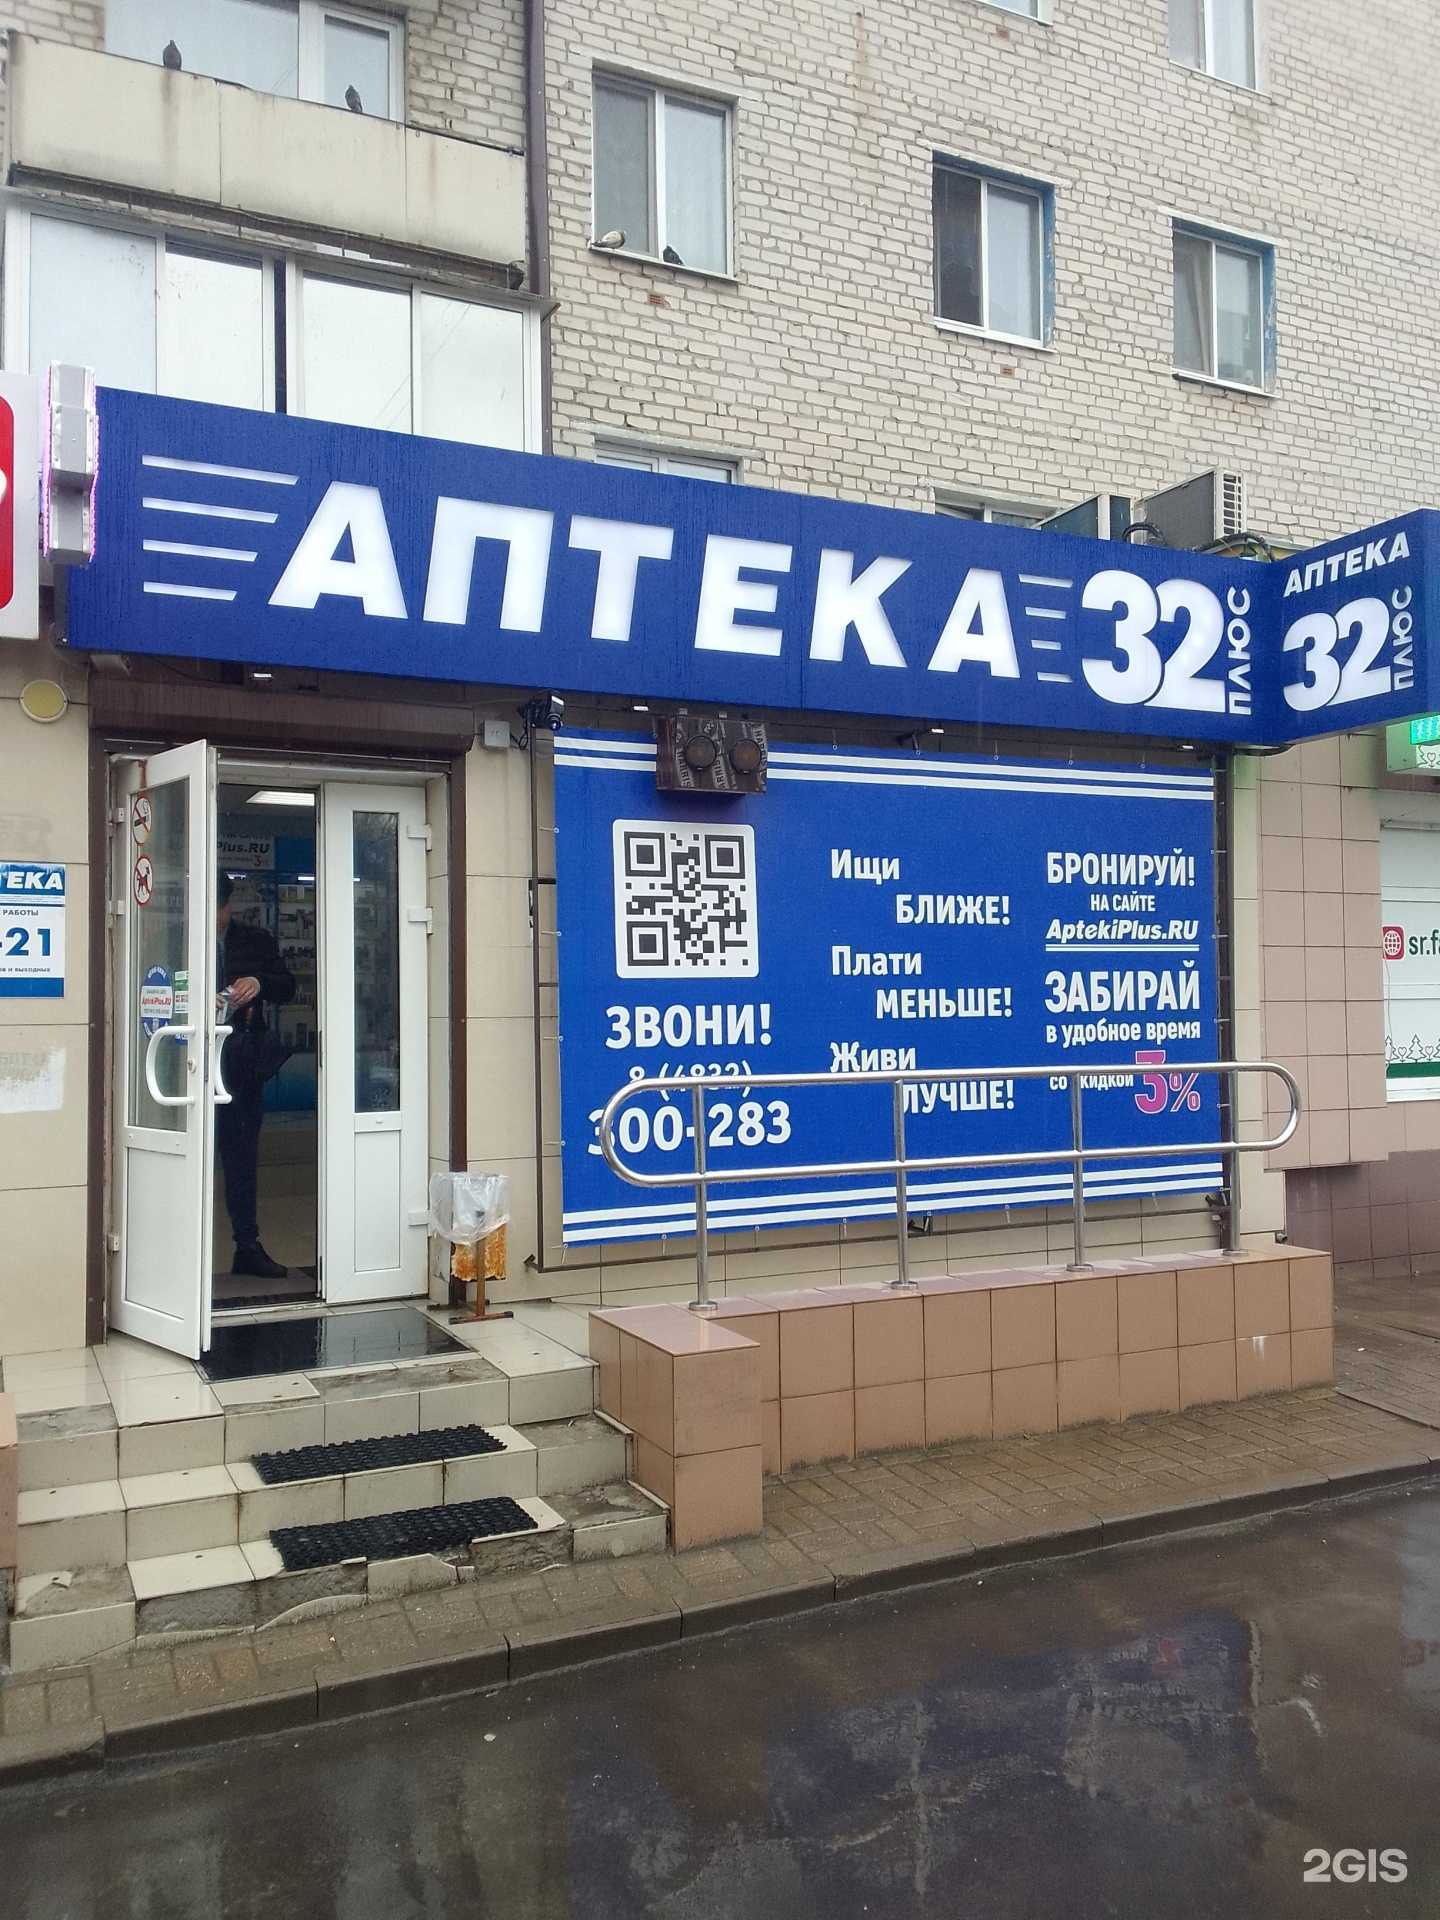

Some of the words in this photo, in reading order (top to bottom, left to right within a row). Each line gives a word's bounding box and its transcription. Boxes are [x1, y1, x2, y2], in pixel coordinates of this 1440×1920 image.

[1283, 532, 1411, 597] АПТЕКА
[268, 480, 1020, 679] АПТЕКА
[1082, 569, 1226, 714] 32
[1227, 586, 1252, 715] ПЛЮС
[1283, 597, 1392, 711] 32
[1391, 585, 1414, 690] ПЛЮС
[831, 849, 900, 885] Ищи
[1047, 847, 1195, 886] БРОНИРУЙ!
[896, 894, 1010, 925] БЛИЖЕ!
[1090, 894, 1110, 911] НА
[1112, 890, 1155, 911] САЙТЕ
[0, 927, 51, 957] 21
[1045, 918, 1199, 943] AptekiPlus.RU
[1408, 929, 1440, 956] sr.f
[831, 945, 922, 976] Плати
[1045, 960, 1200, 1013] ЗАБИРАЙ
[876, 987, 1012, 1019] МЕНЬШЕ!
[605, 1003, 772, 1049] ЗВОНИ!
[1046, 1025, 1057, 1043] в
[1062, 1018, 1141, 1048] удобное
[1146, 1021, 1200, 1044] время
[830, 1041, 916, 1072] Живи
[902, 1079, 1015, 1114] ЛУЧШЕ!
[1050, 1076, 1067, 1090] со
[1079, 1074, 1133, 1091] кидкой
[588, 1100, 792, 1155] 300-283
